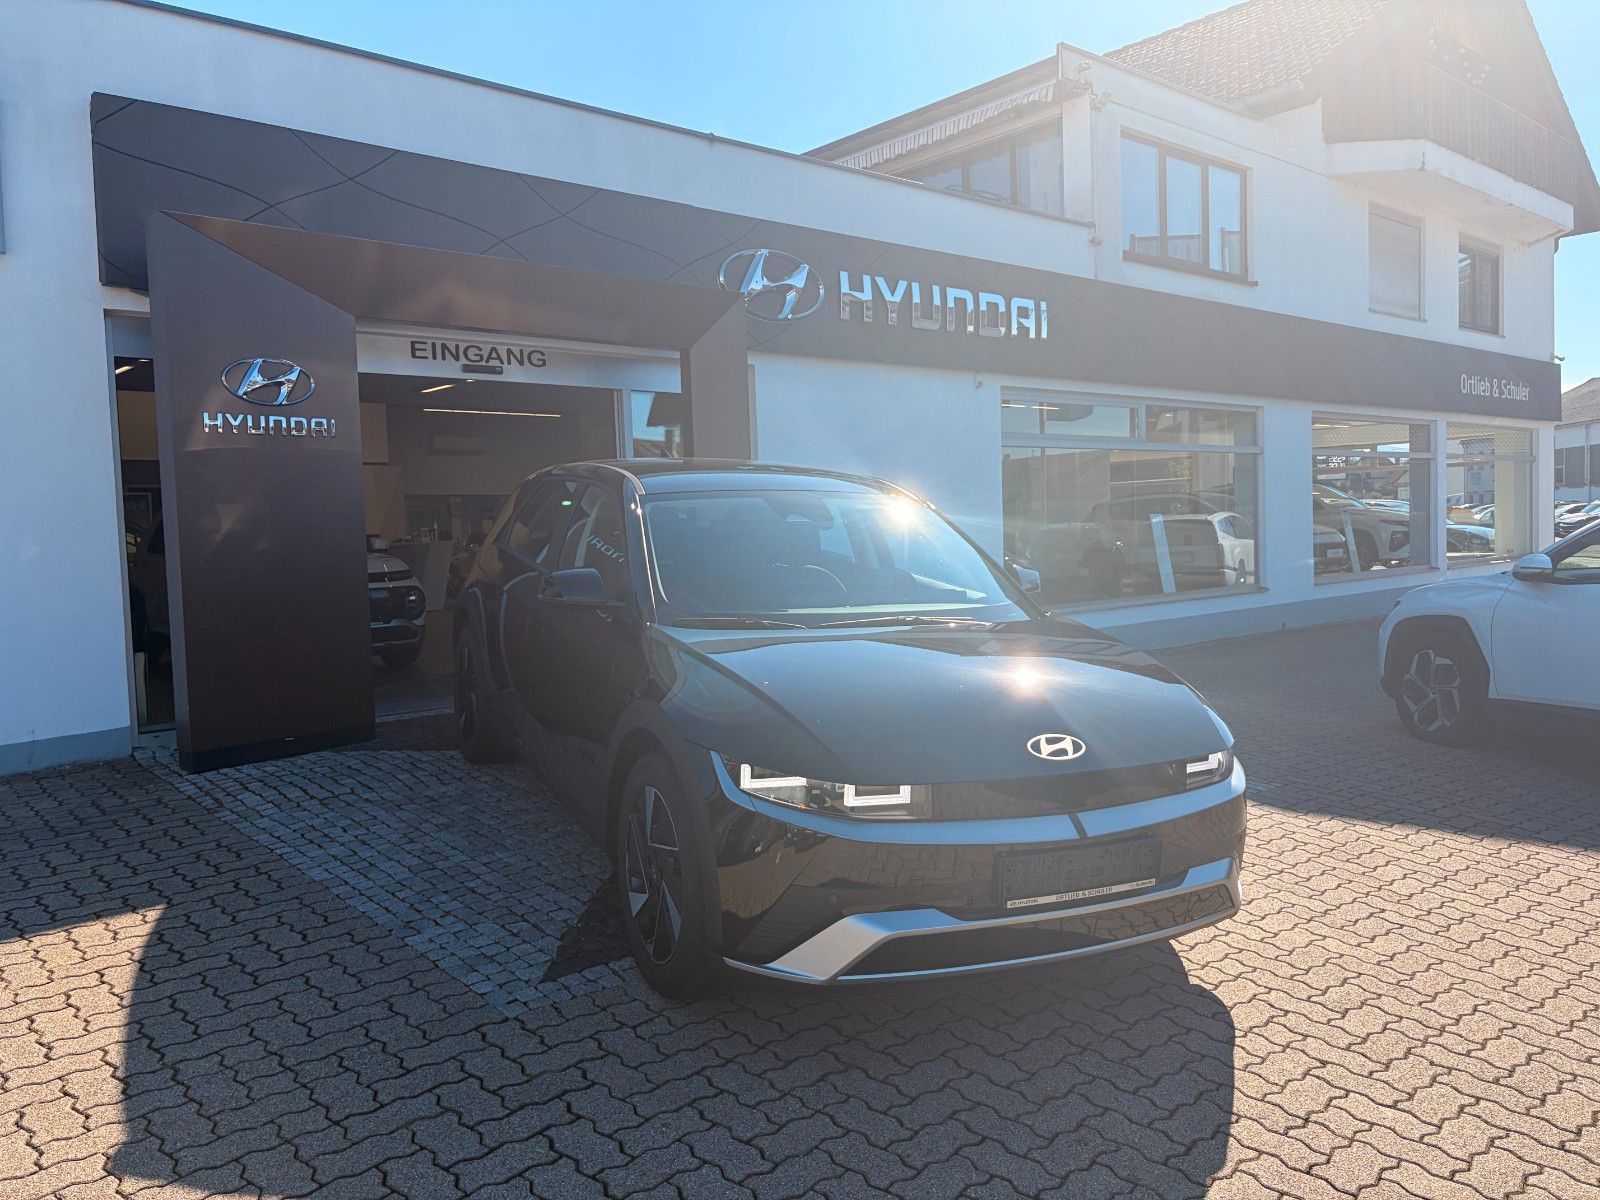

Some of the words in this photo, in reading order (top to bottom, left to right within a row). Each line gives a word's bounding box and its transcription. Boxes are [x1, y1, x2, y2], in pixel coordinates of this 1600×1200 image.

[839, 270, 1049, 340] HYUNDAI
[410, 340, 547, 368] EINGANG
[1460, 373, 1491, 397] Ortlieb
[1492, 378, 1500, 398] &
[1501, 380, 1530, 402] Schuler
[202, 411, 336, 438] HYUNDAI
